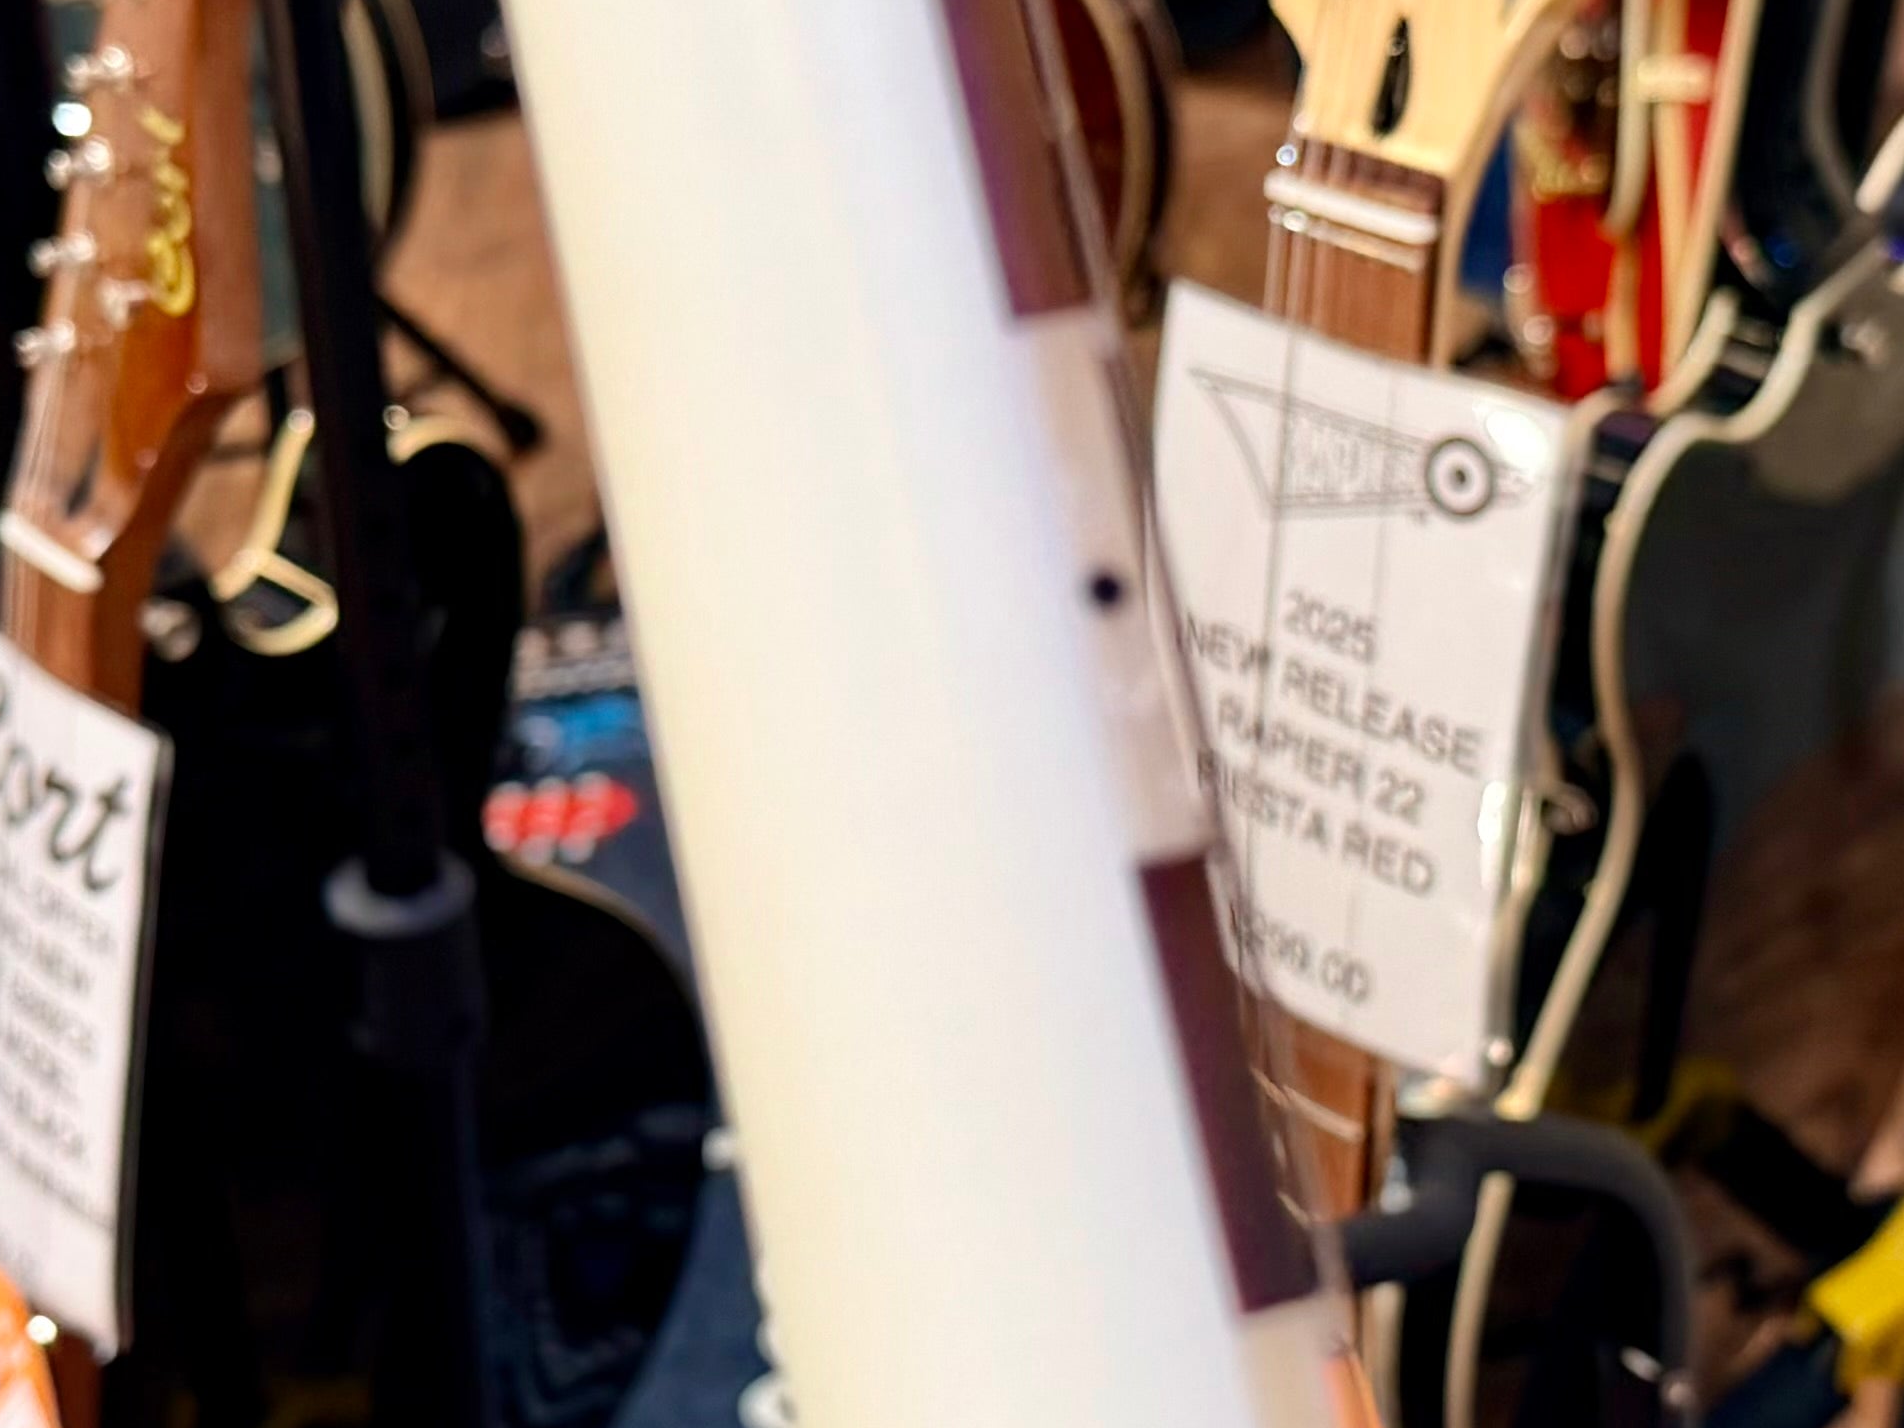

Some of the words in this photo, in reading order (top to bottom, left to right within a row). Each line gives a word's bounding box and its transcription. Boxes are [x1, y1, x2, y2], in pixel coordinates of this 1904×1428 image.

[1284, 589, 1376, 665] 2025
[1217, 692, 1363, 802] RAPIER
[1375, 766, 1426, 826] 22
[1283, 654, 1485, 778] RELEASE
[1343, 822, 1434, 899] RED
